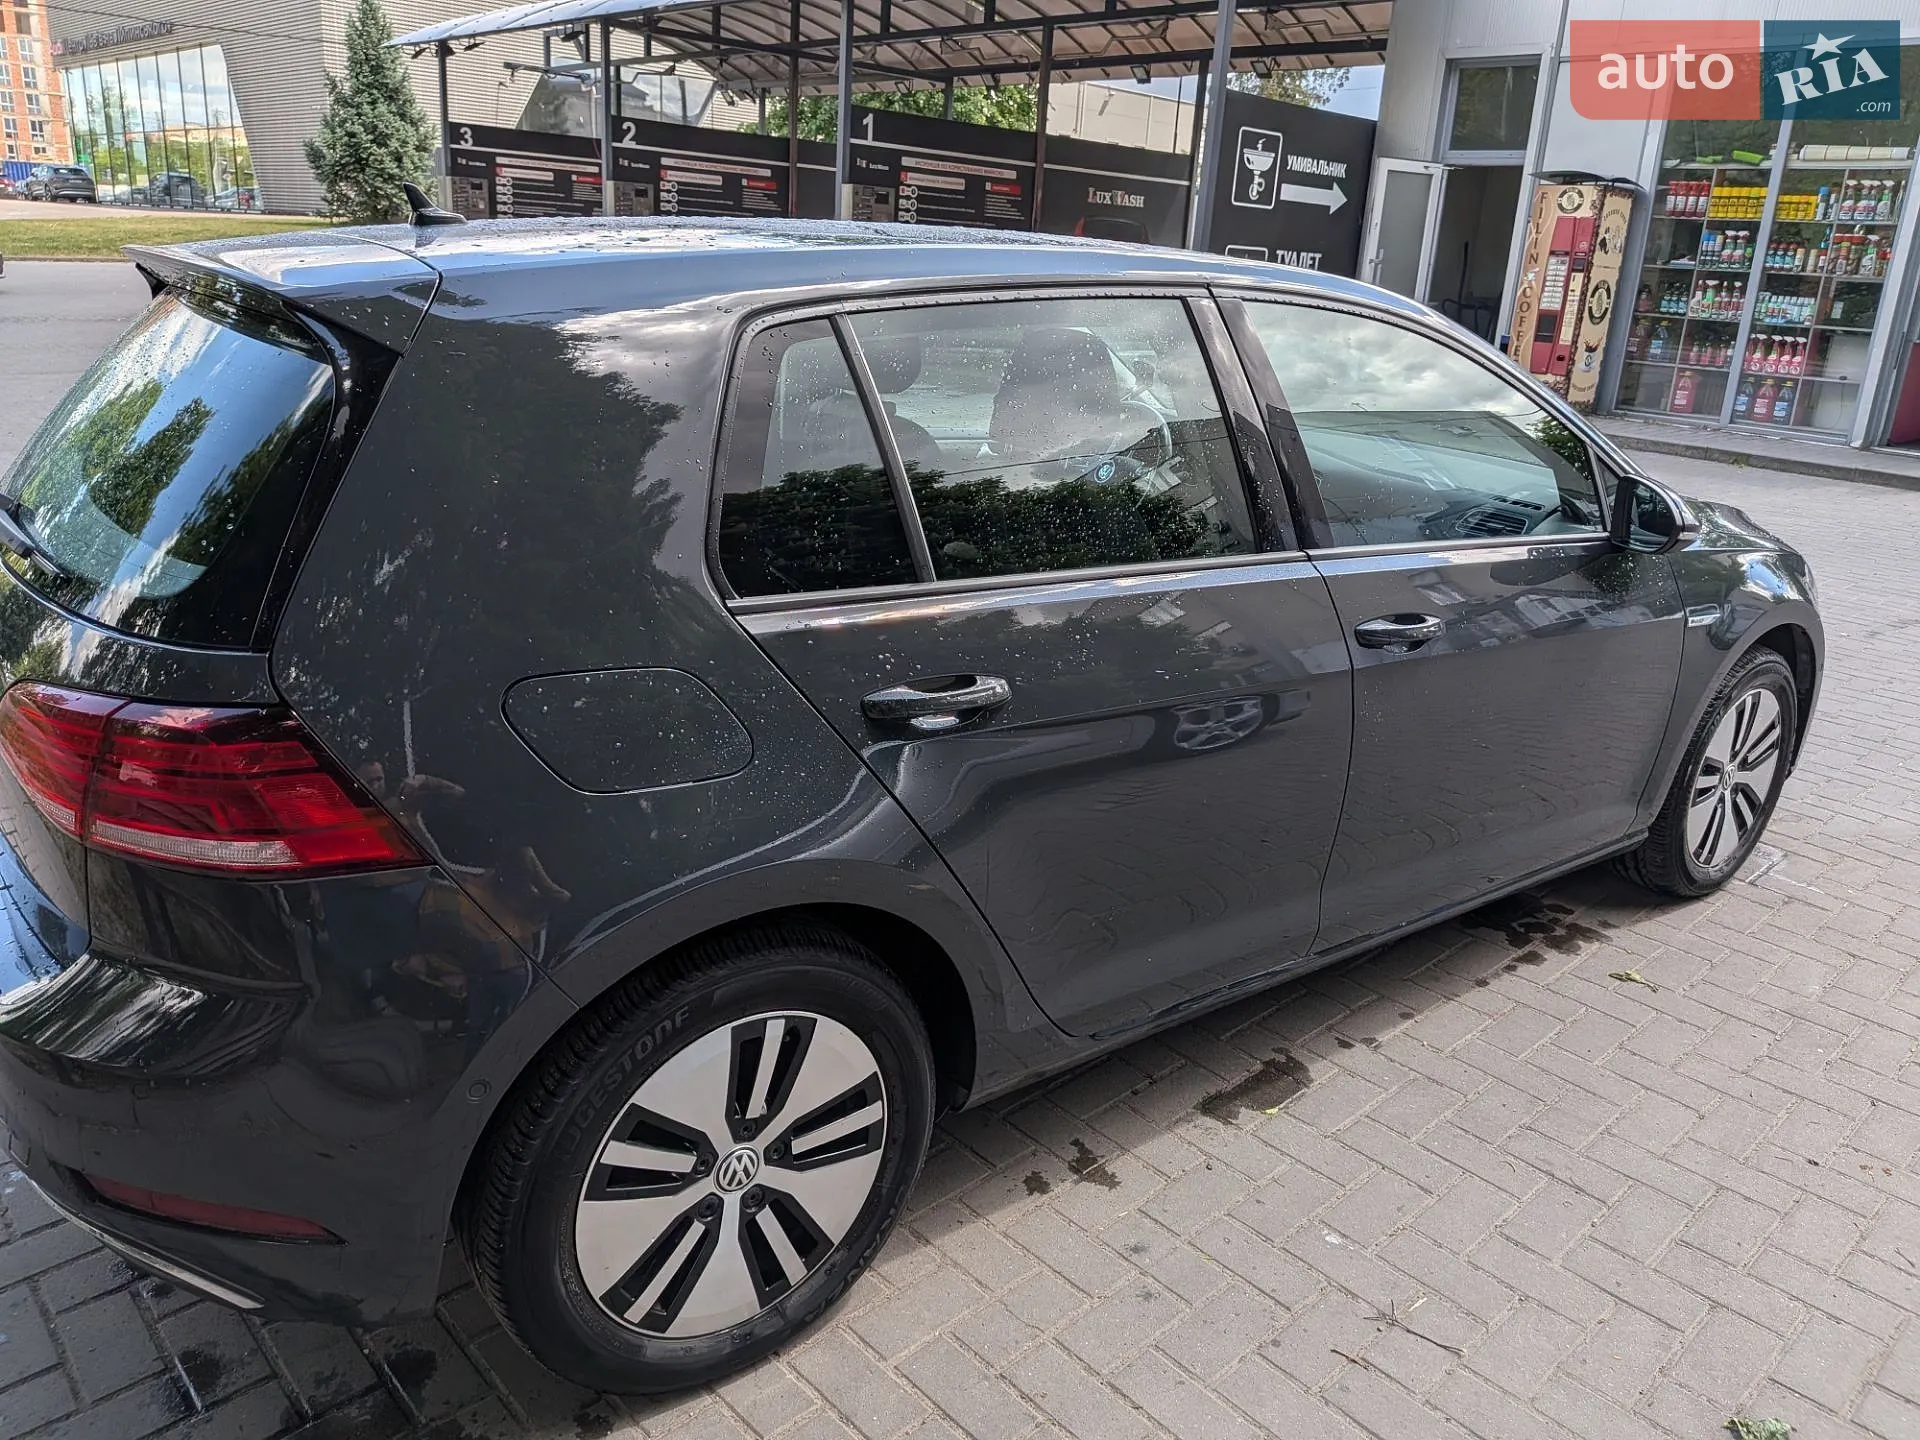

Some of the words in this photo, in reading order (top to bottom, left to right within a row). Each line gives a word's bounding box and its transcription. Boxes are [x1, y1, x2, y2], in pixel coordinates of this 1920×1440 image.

[459, 127, 473, 147] 3
[621, 121, 637, 146] 2
[862, 113, 874, 142] 1
[1286, 154, 1347, 179] УМИВАЛЬНИК
[1529, 191, 1548, 266] FILIN
[1276, 250, 1322, 270] ТУАЛЕТ
[1513, 287, 1532, 361] COFFE
